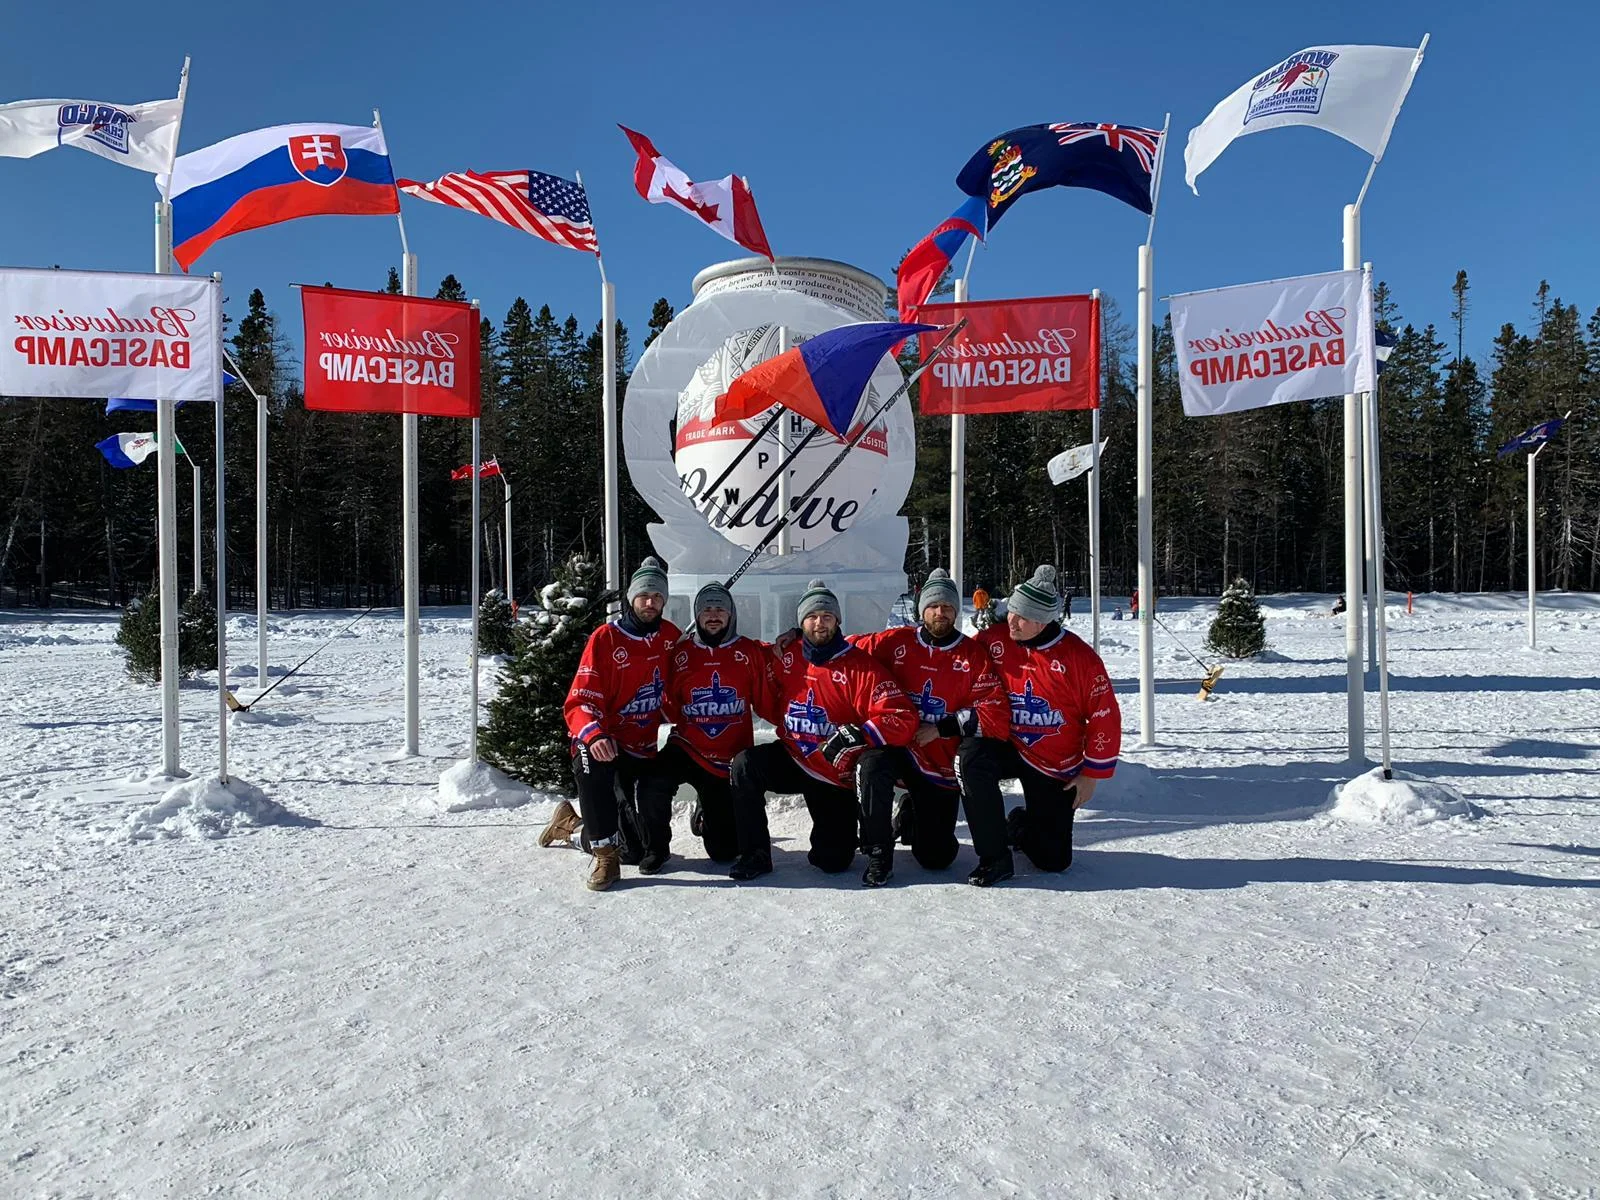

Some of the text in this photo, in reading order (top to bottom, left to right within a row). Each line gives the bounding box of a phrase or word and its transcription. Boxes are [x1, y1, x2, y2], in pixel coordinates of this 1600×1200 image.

[795, 279, 836, 291] produces
[819, 273, 841, 285] much
[821, 293, 833, 301] no
[834, 296, 857, 308] other
[685, 426, 736, 440] TRADE MARK
[758, 452, 769, 469] P
[724, 488, 740, 505] W
